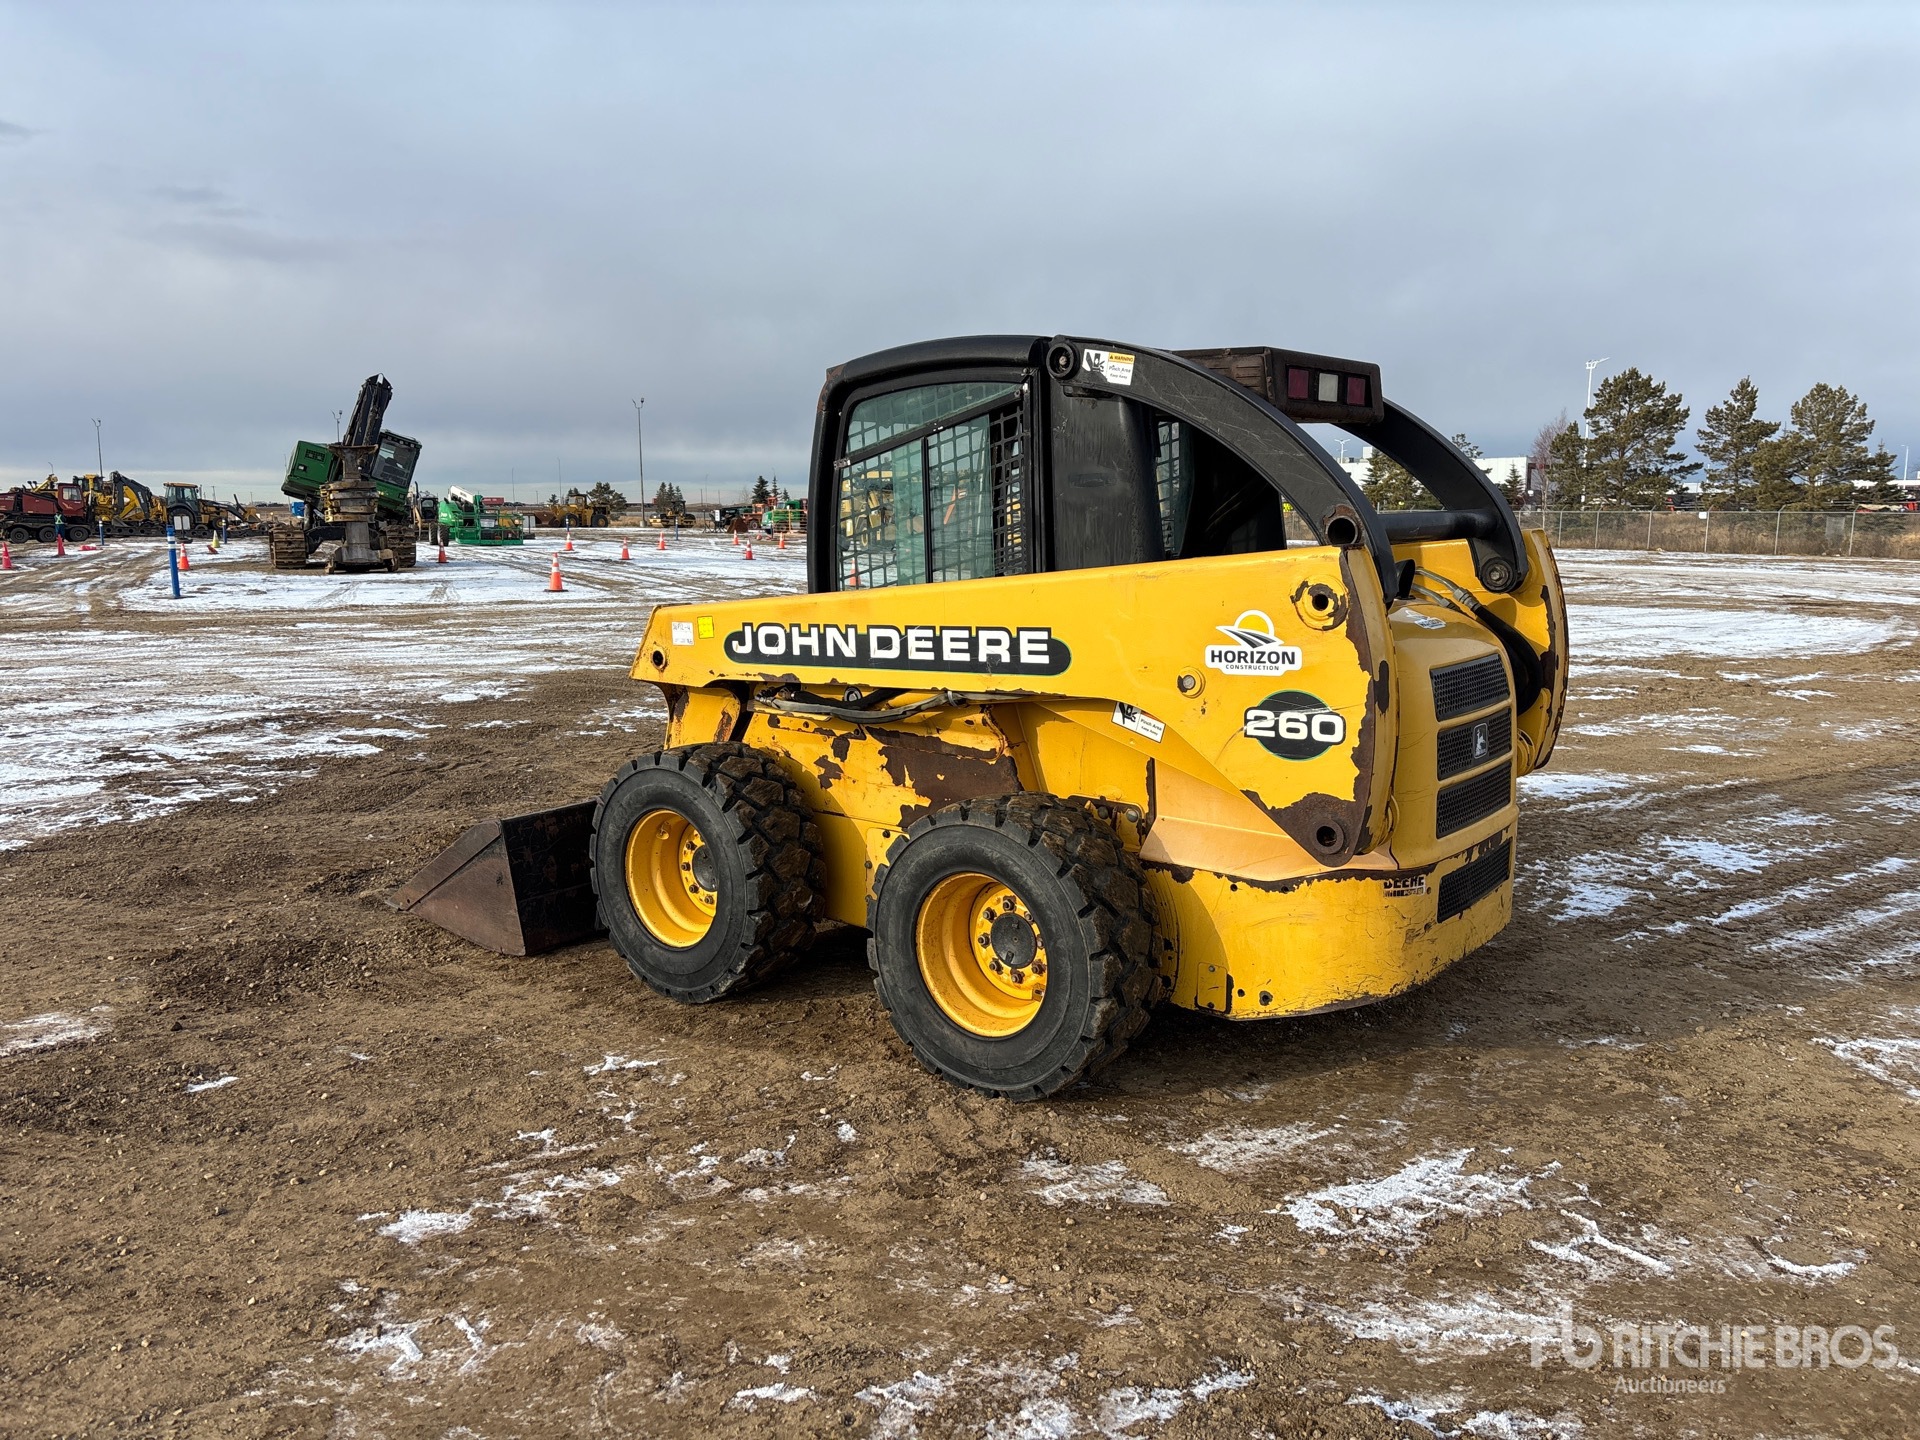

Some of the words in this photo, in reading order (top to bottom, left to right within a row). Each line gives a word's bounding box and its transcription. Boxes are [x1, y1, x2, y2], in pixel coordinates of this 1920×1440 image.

[1114, 355, 1134, 363] WARNING
[732, 625, 857, 657] JOHN
[868, 628, 1050, 664] DEERE
[1211, 650, 1296, 665] HORIZON
[1246, 709, 1344, 743] 260
